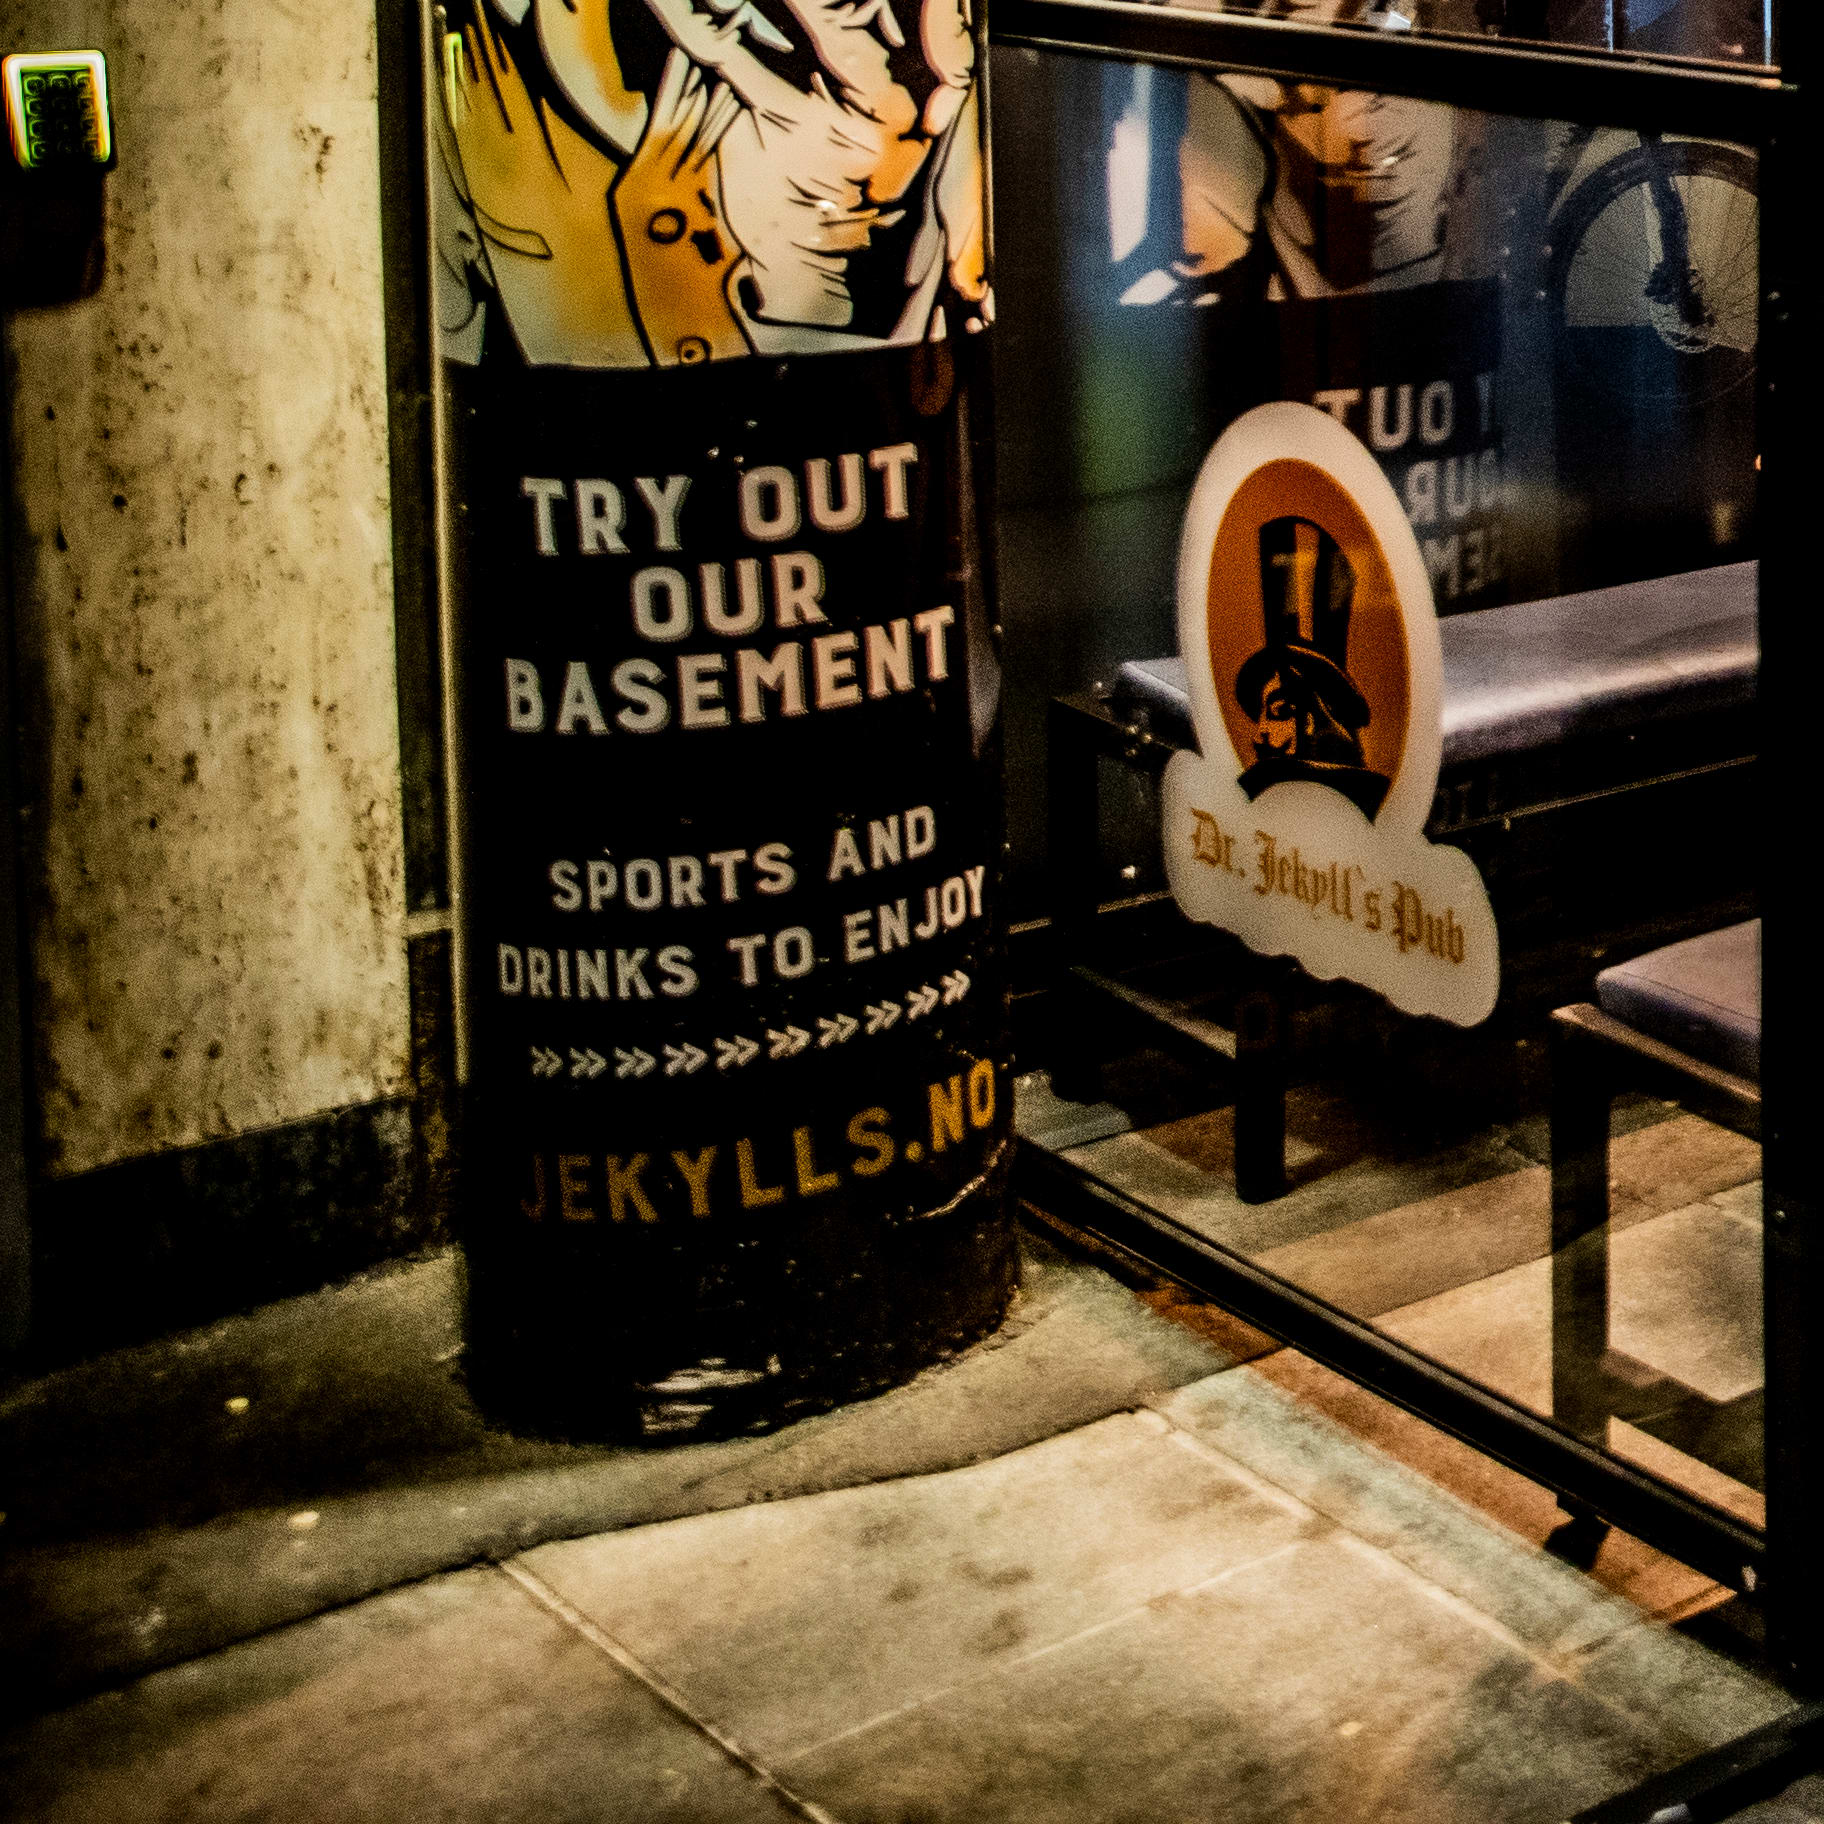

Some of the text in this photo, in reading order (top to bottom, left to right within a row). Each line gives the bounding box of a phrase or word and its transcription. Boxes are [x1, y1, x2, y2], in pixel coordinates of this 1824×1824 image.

[520, 441, 918, 556] TRY OUT
[630, 550, 829, 643] OUR
[503, 605, 955, 736] BASEMENT
[548, 805, 937, 912] SPORTS AND
[1190, 807, 1246, 878] Dr.
[1390, 881, 1465, 964] Pub
[499, 865, 986, 1000] DRINKS TO ENJOY
[520, 1058, 997, 1223] JEKYLLS.NO
